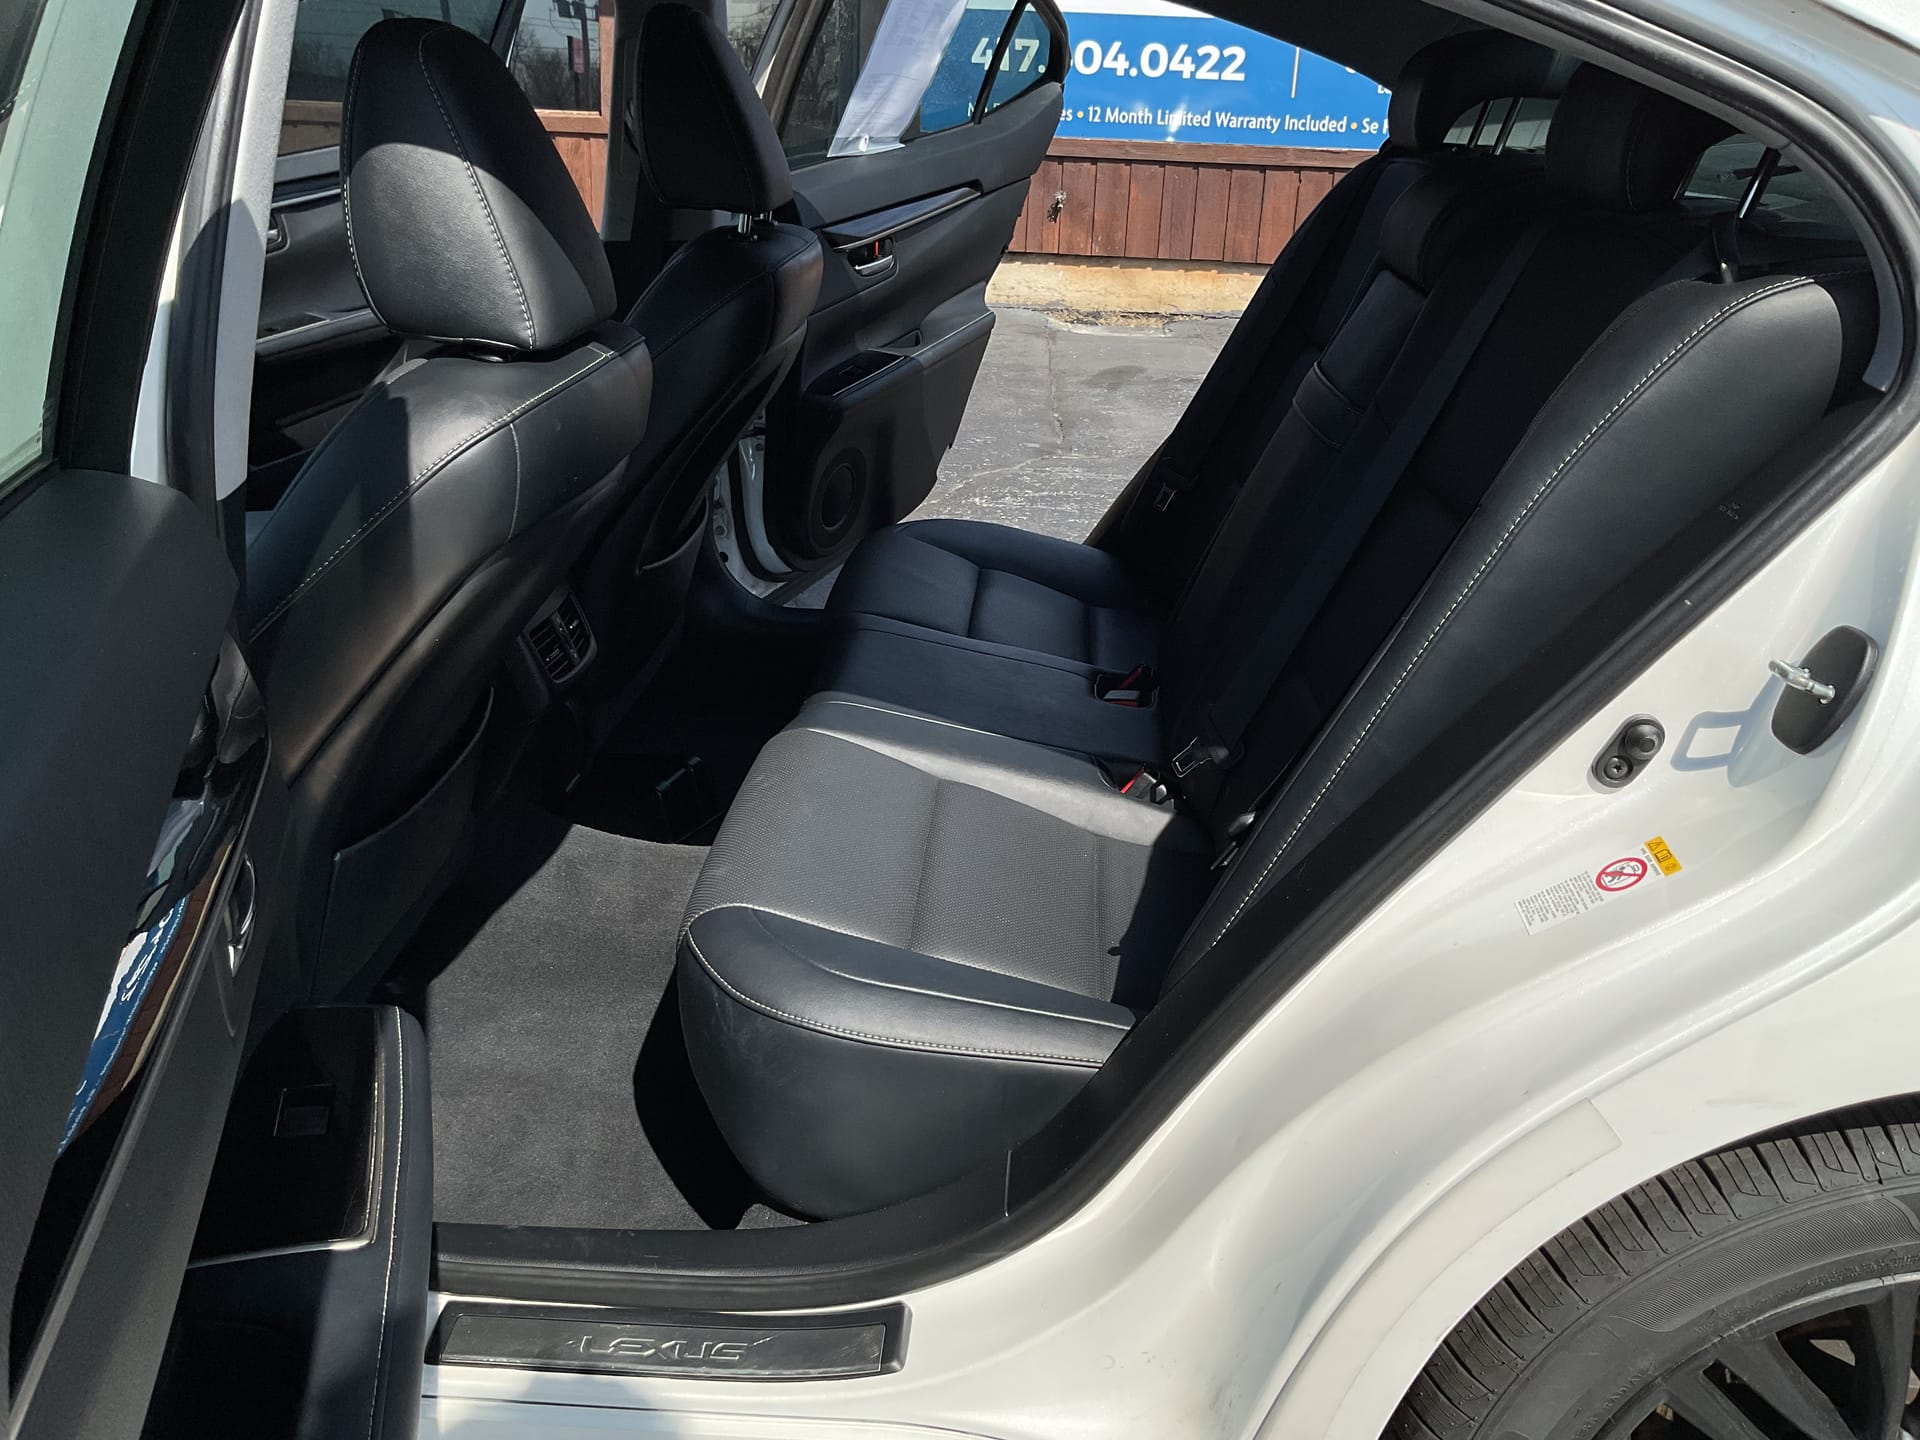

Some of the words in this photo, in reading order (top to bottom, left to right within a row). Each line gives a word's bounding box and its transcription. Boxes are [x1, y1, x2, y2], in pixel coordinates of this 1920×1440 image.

[971, 37, 1246, 81] 47.04.0422
[1088, 106, 1101, 123] 12
[1105, 107, 1153, 125] Month
[1157, 107, 1211, 128] Limited
[1215, 112, 1280, 134] Warranty
[1284, 114, 1348, 133] Included
[1361, 118, 1379, 134] Se
[579, 1335, 749, 1361] LEXUS
